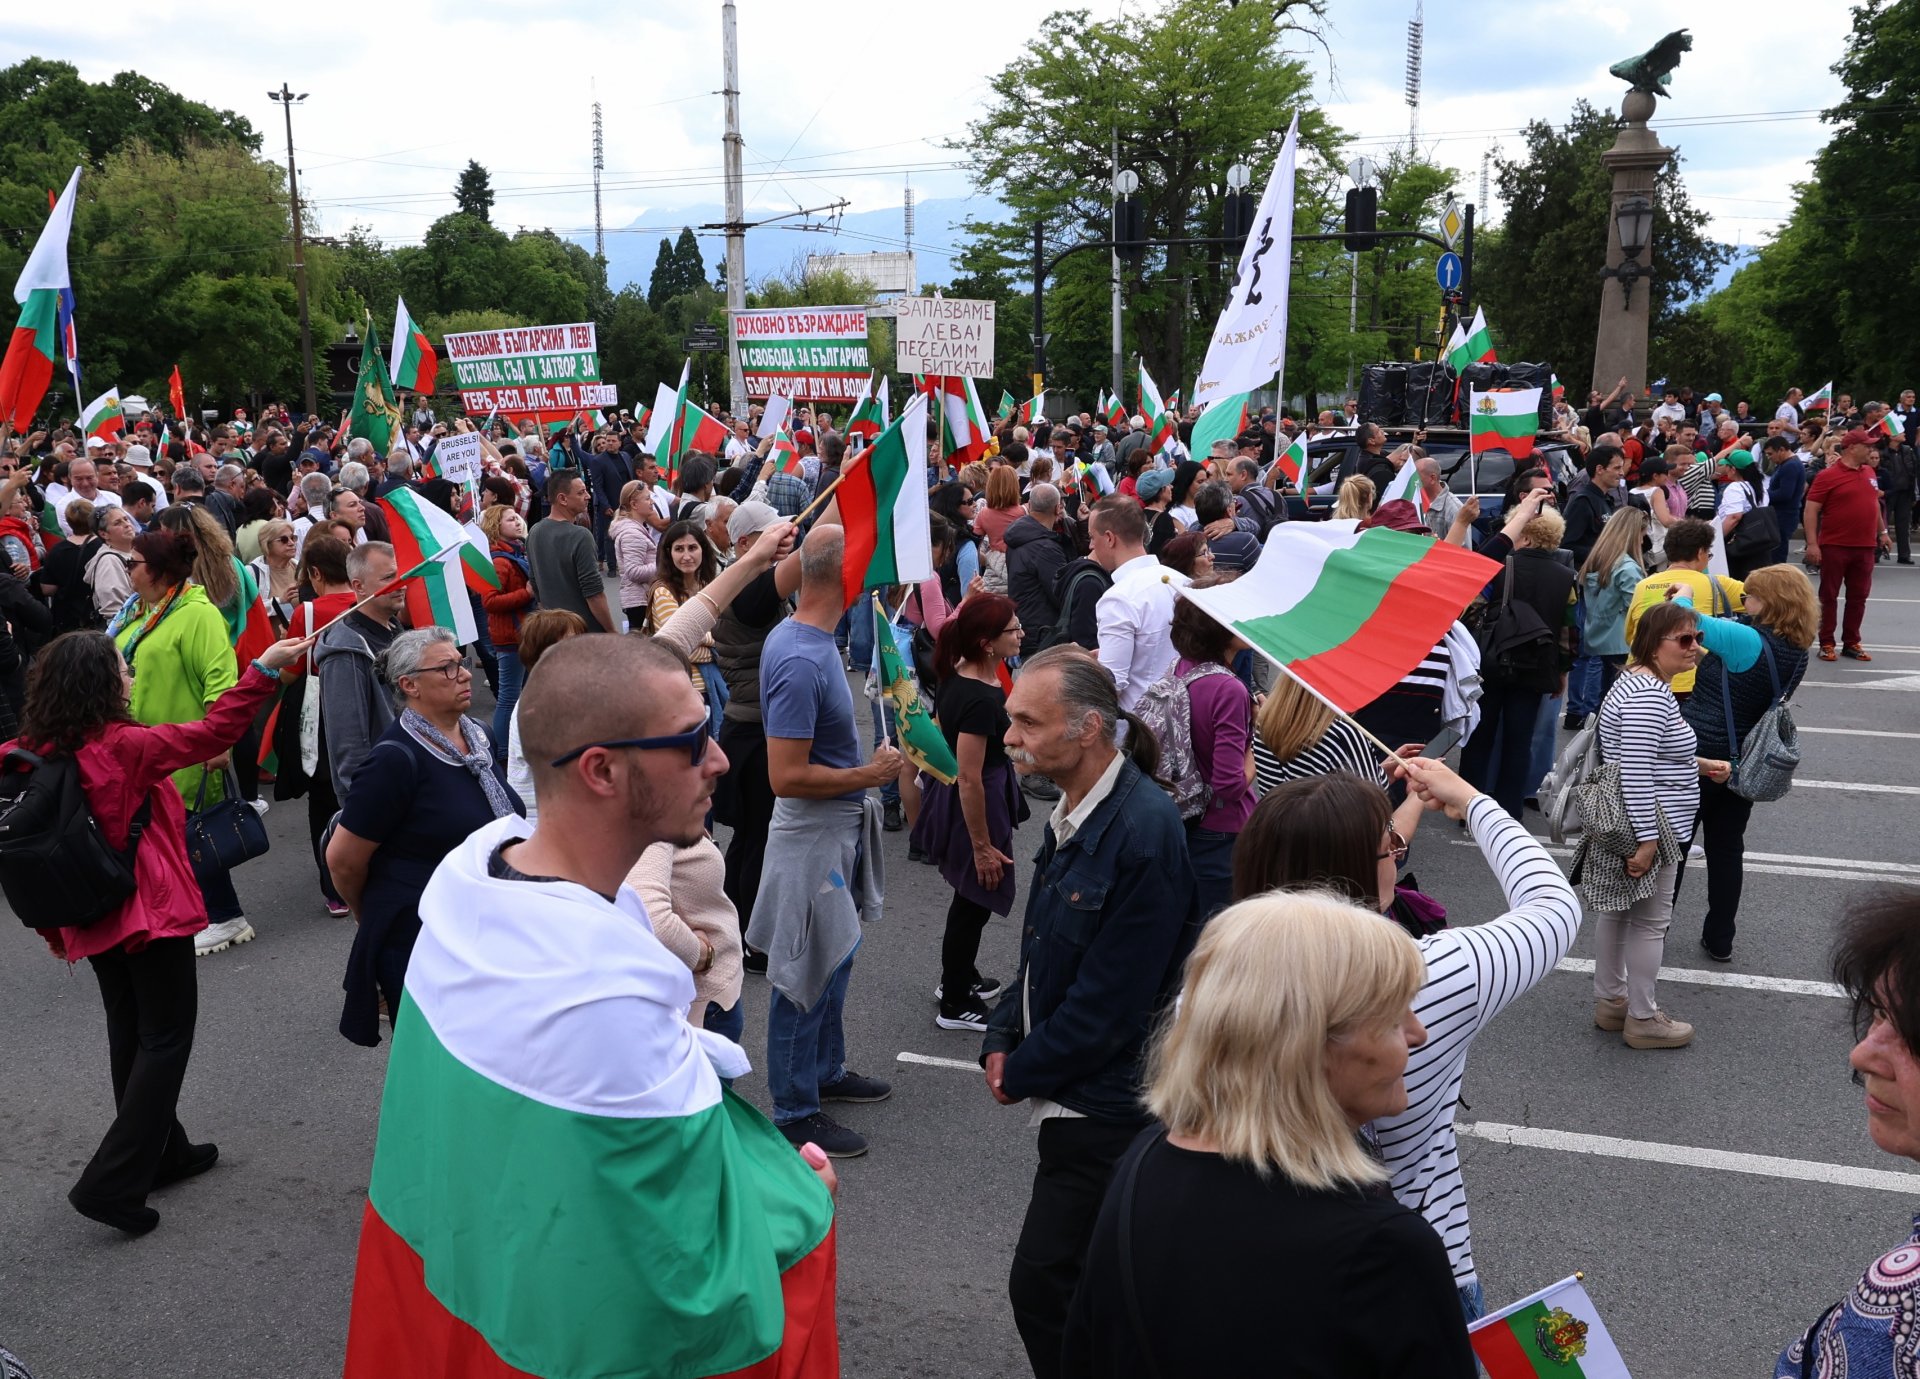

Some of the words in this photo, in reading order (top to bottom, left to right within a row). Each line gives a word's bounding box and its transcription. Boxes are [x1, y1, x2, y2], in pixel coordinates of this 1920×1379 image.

[898, 299, 993, 321] ЗАПАЗВАМЕ
[736, 315, 785, 337] ДУХОВНО
[787, 313, 865, 336] ВЪЗРАЖДАНЕ
[922, 322, 981, 341] ЛЕВА!
[448, 333, 503, 359] ЗАПАЗВАМЕ
[503, 327, 565, 354] БЪЛГАРСКИЯ
[570, 326, 592, 349] ЛЕВ!
[457, 361, 505, 385] ОСТАВКА,
[503, 359, 527, 384] СЪД
[528, 358, 537, 380] И
[539, 355, 577, 379] ЗАТВОР
[581, 354, 596, 377] ЗА
[740, 348, 749, 366] И
[749, 348, 796, 370] СВОБОДА
[797, 347, 811, 367] ЗА
[811, 347, 869, 367] БЪЛГАРИЯ!
[922, 358, 993, 377] БИТКАТА!
[496, 387, 525, 411] БСП,
[525, 387, 555, 411] ДПС,
[555, 386, 577, 408] ПП,
[809, 377, 827, 400] ДУХ
[828, 378, 841, 396] НИ
[441, 435, 479, 450] BRUSSELS!
[446, 452, 460, 462] ARE
[461, 448, 476, 458] YOU
